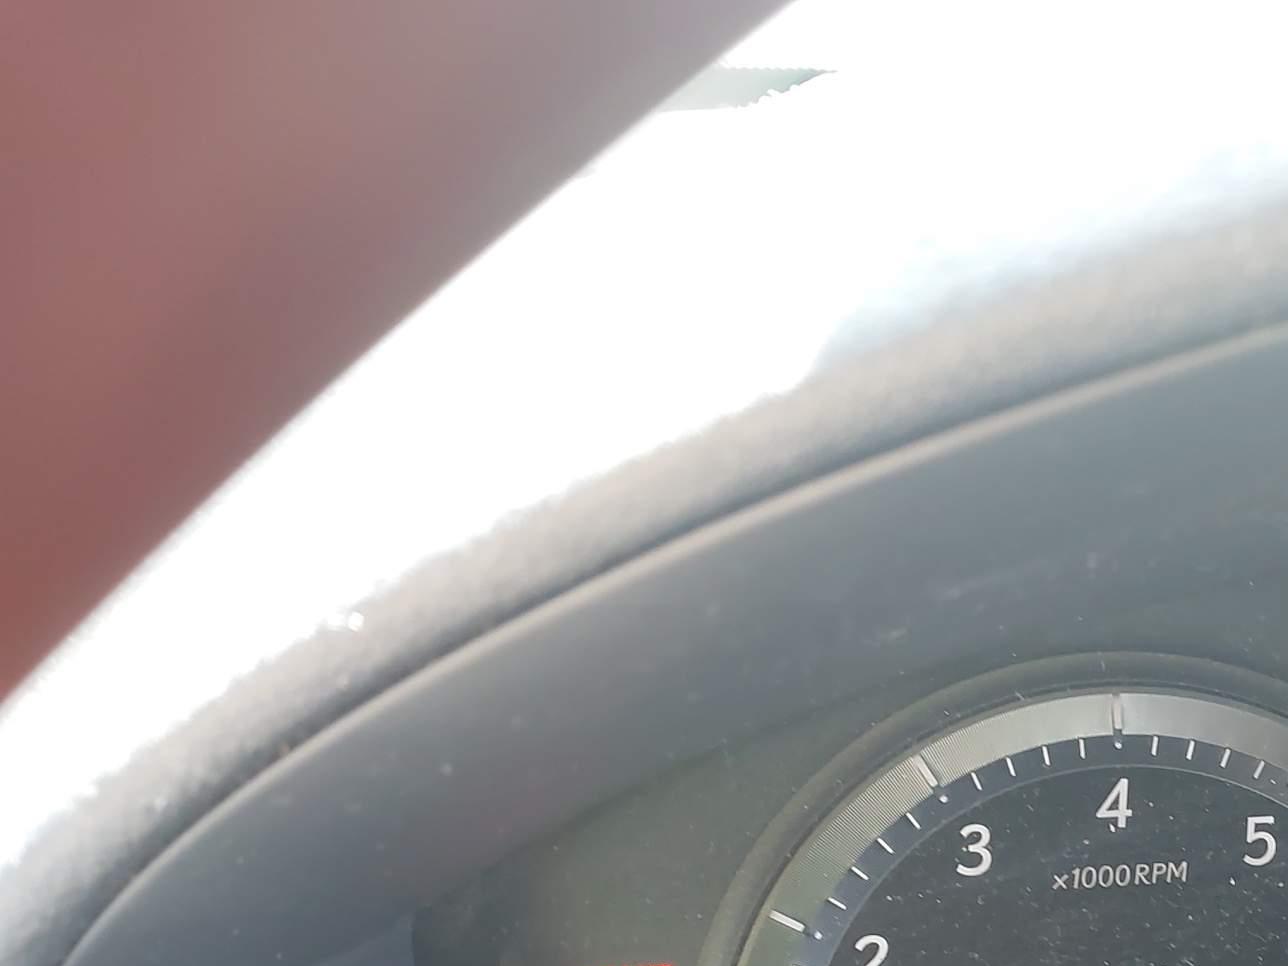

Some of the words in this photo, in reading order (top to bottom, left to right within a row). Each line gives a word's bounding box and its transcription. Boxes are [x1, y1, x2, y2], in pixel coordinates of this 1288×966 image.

[1096, 777, 1133, 828] 4
[955, 824, 993, 877] 3
[1243, 815, 1278, 866] 5
[1133, 860, 1188, 886] RPM
